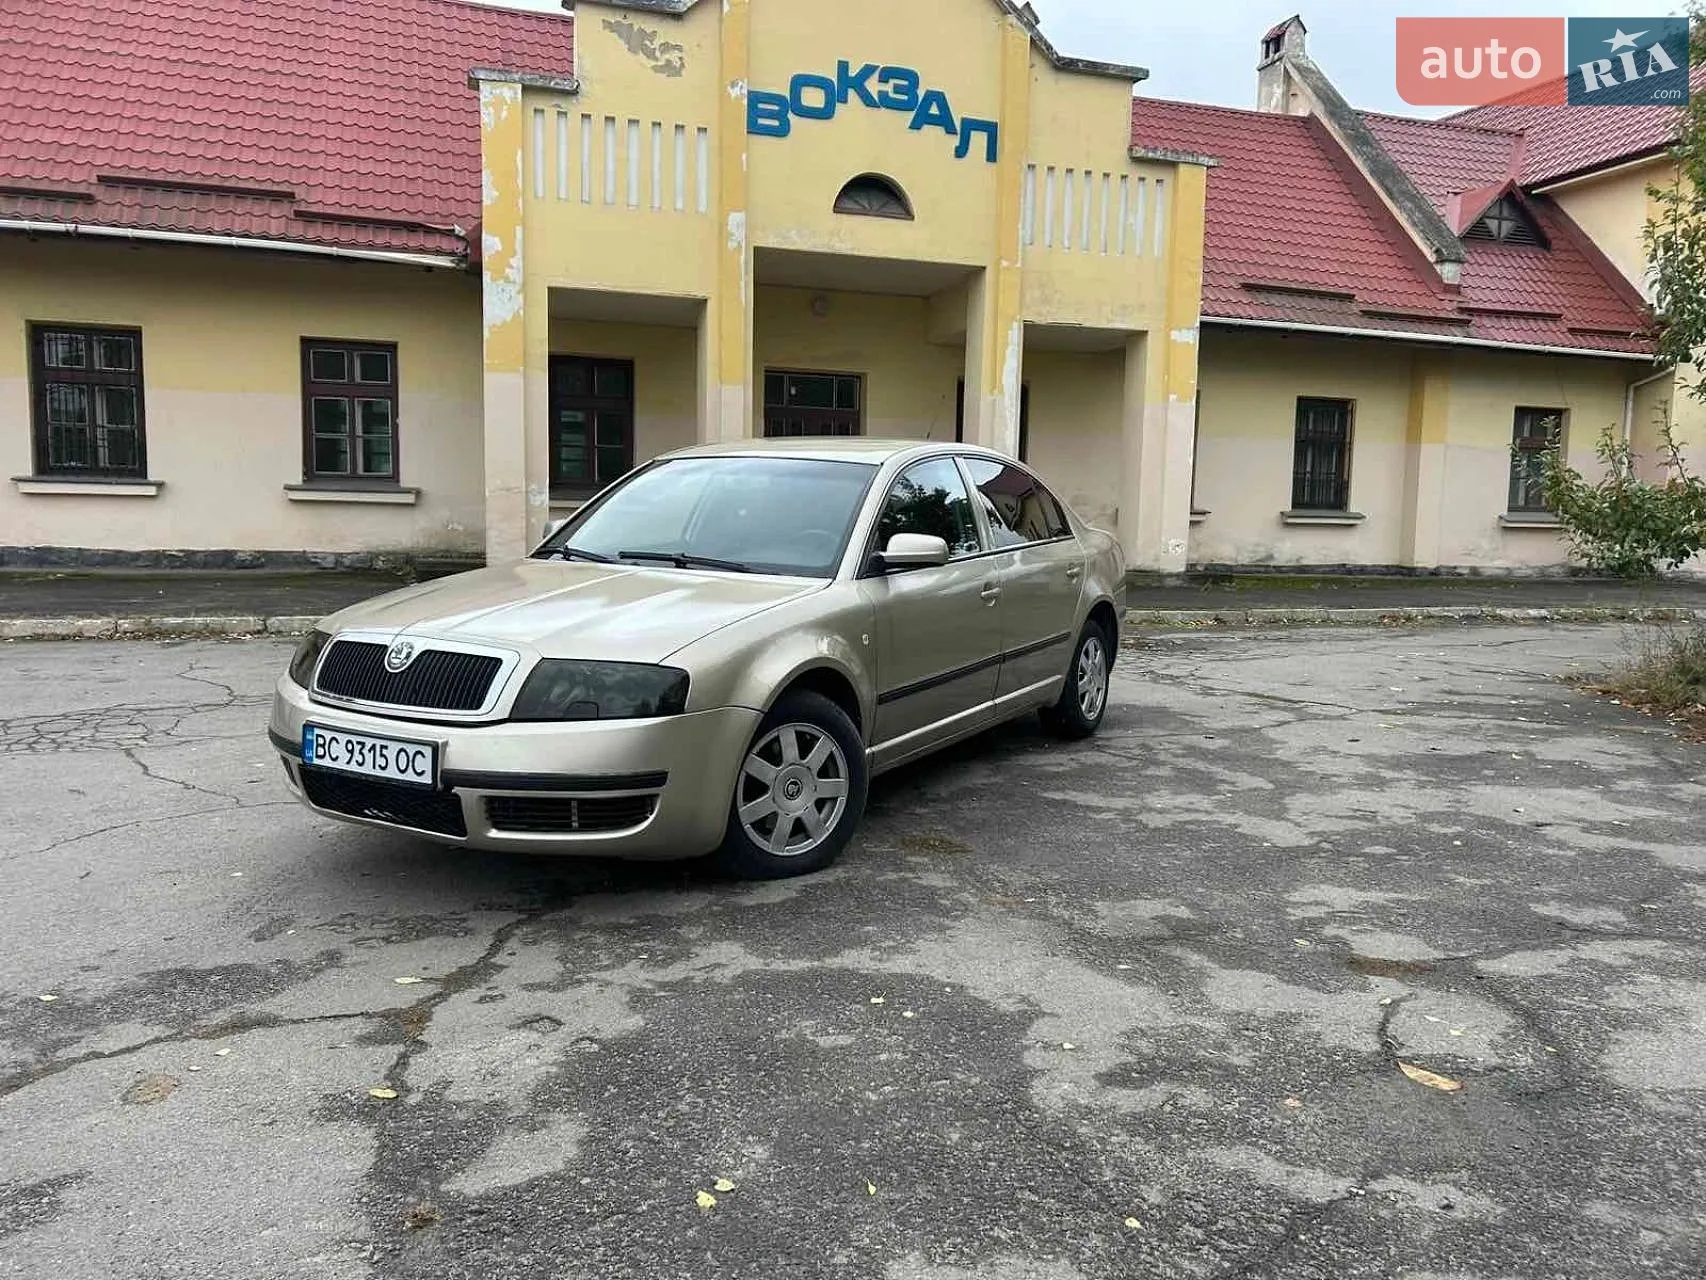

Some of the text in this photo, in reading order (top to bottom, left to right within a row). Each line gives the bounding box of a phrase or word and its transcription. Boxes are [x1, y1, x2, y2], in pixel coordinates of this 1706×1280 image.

[747, 59, 998, 163] ВОКЗАЛ
[315, 733, 426, 777] BC 9315 OC
